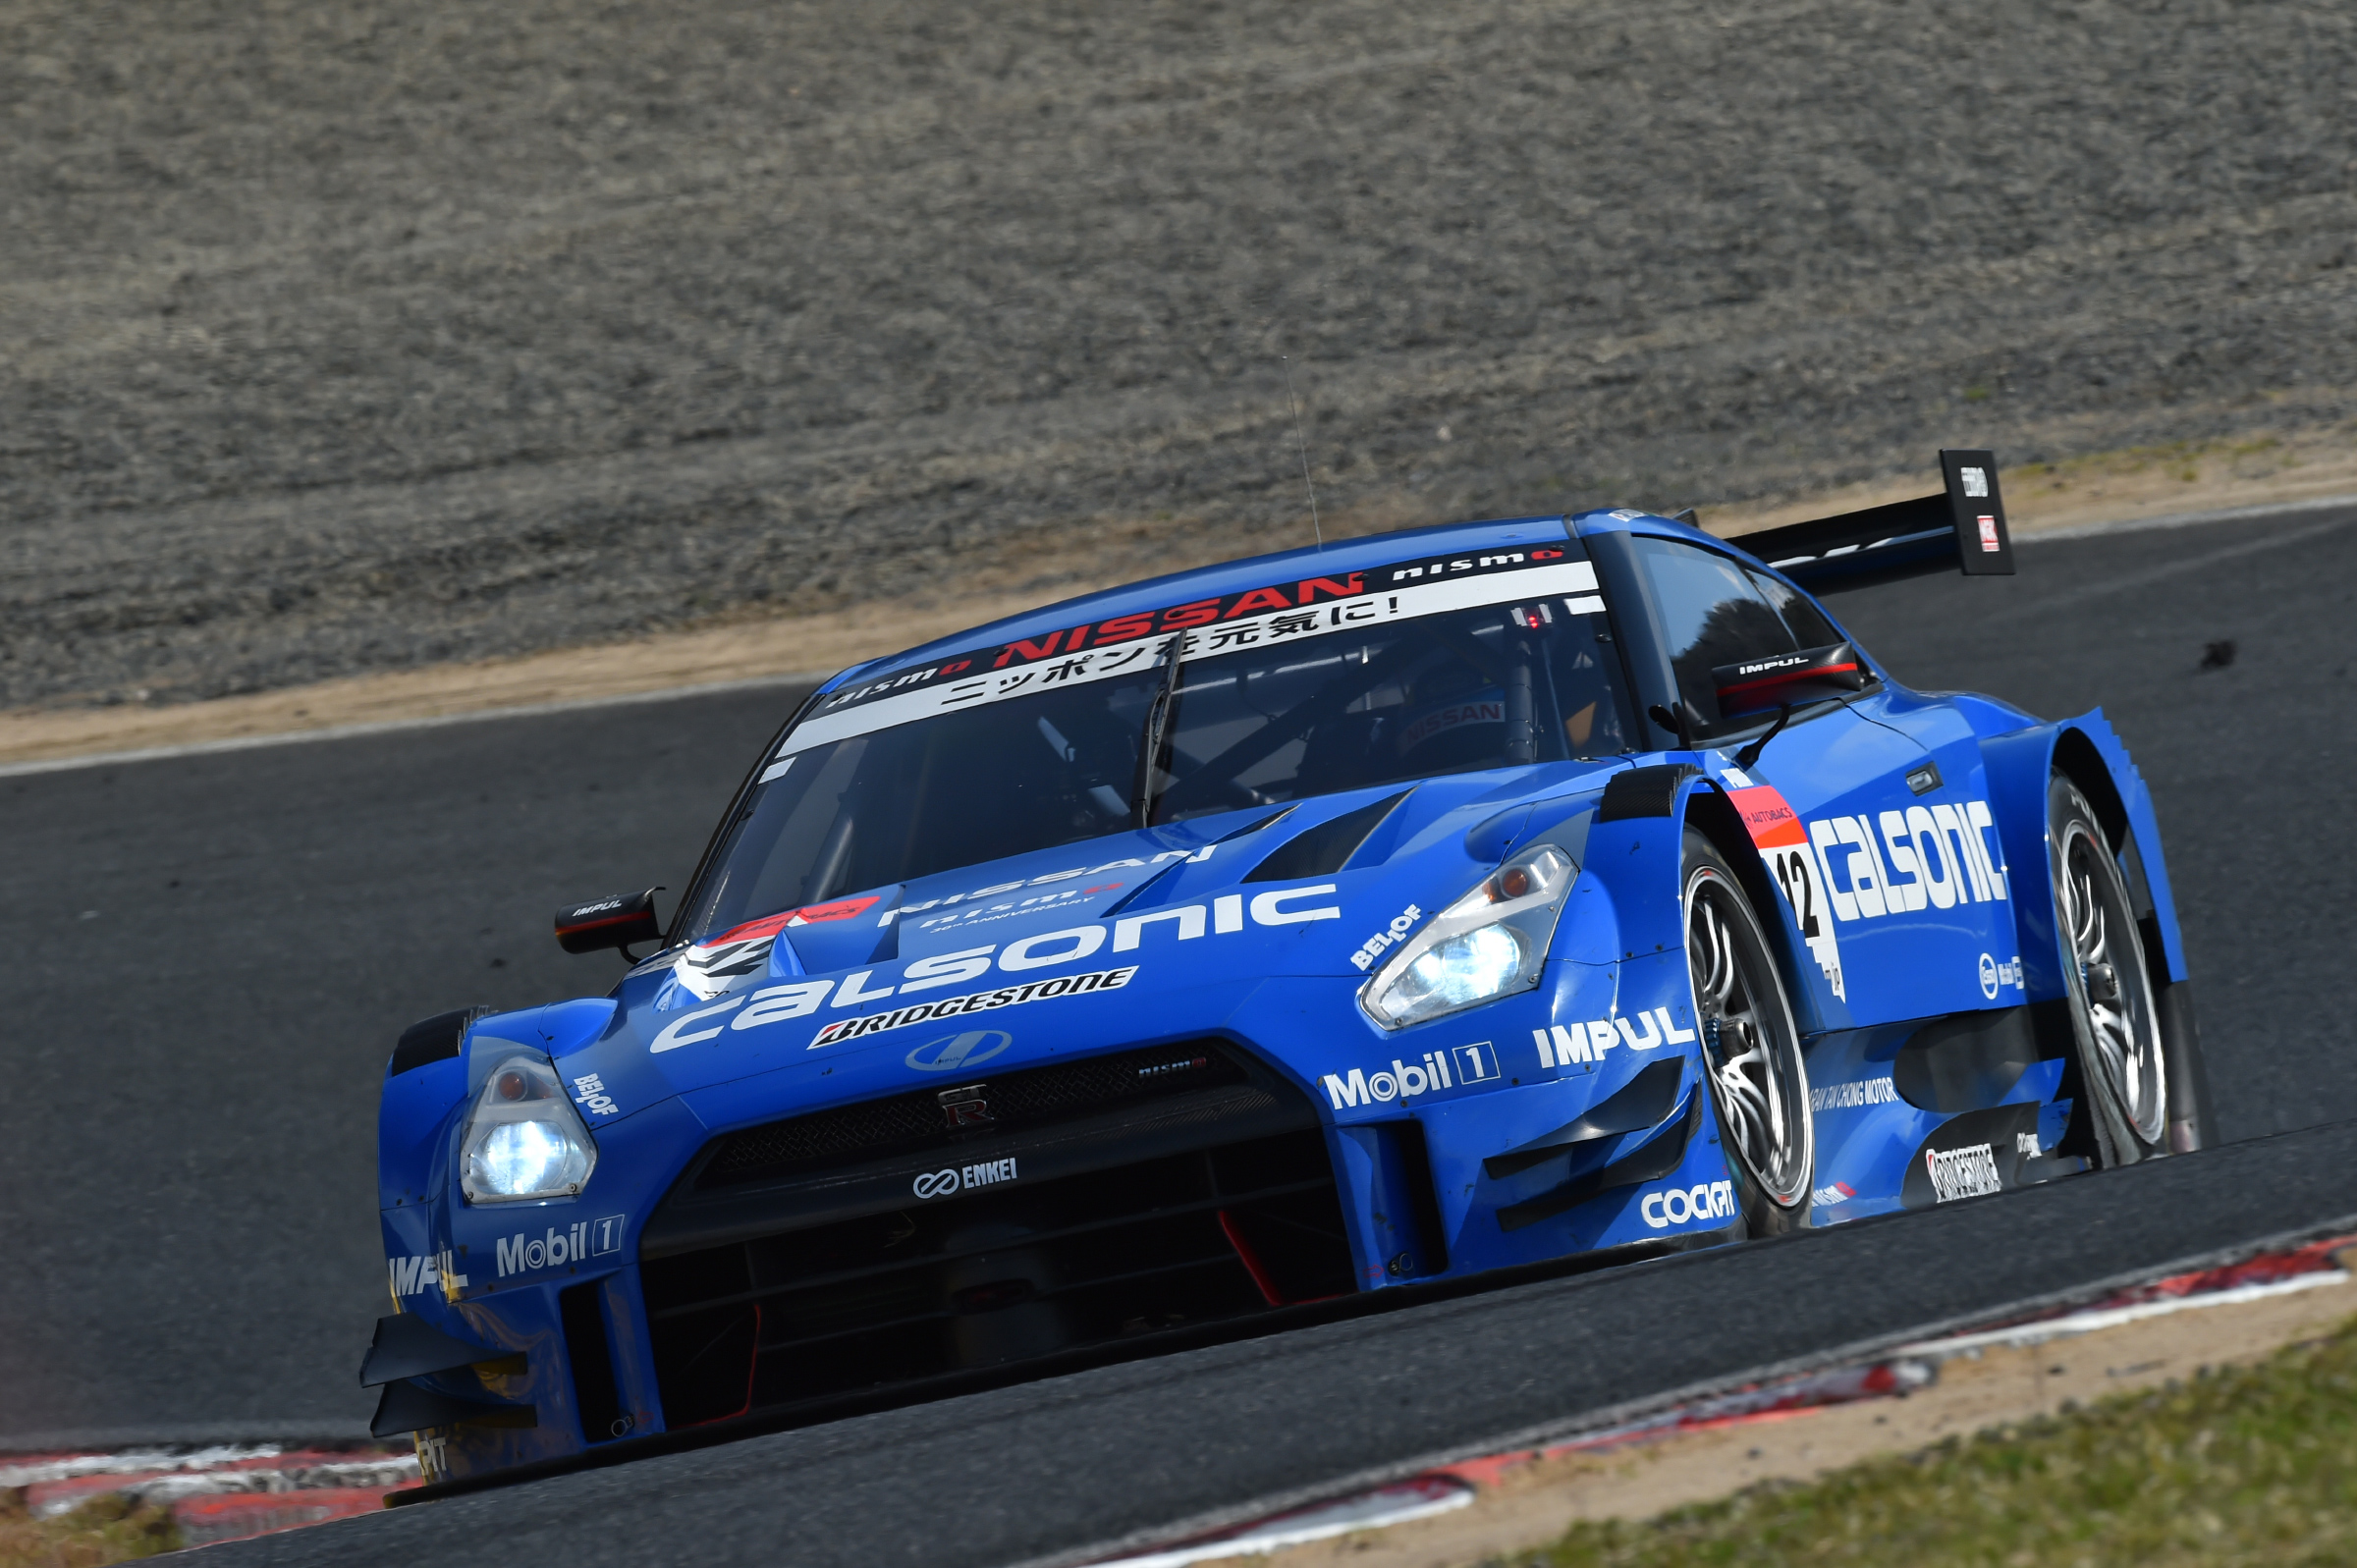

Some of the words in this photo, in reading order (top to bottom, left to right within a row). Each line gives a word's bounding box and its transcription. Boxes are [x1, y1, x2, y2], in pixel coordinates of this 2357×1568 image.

[1393, 550, 1563, 581] nismo
[992, 571, 1364, 669] NISSAN
[1739, 656, 1809, 676] IMPUL
[1406, 703, 1501, 744] NISSAN
[1750, 806, 1793, 825] AUTOBACS
[572, 899, 623, 917] IMPUL
[877, 844, 1218, 928] NISSAN
[918, 882, 1125, 929] nismo
[968, 896, 1095, 927] ANNIVERSARY
[1349, 903, 1423, 972] BELLOF
[808, 967, 1137, 1050] BRIDGESTONE
[1532, 1007, 1696, 1069] IMPUL
[574, 1072, 620, 1116] BELLOF
[1323, 1051, 1453, 1110] Mobil
[1836, 1080, 1864, 1108] CHONG
[1865, 1076, 1900, 1105] MOTOR
[961, 1157, 1017, 1190] ENKEI
[1640, 1179, 1736, 1228] COCKPIT
[495, 1220, 588, 1277] Mobil
[389, 1249, 468, 1298] IMPUL
